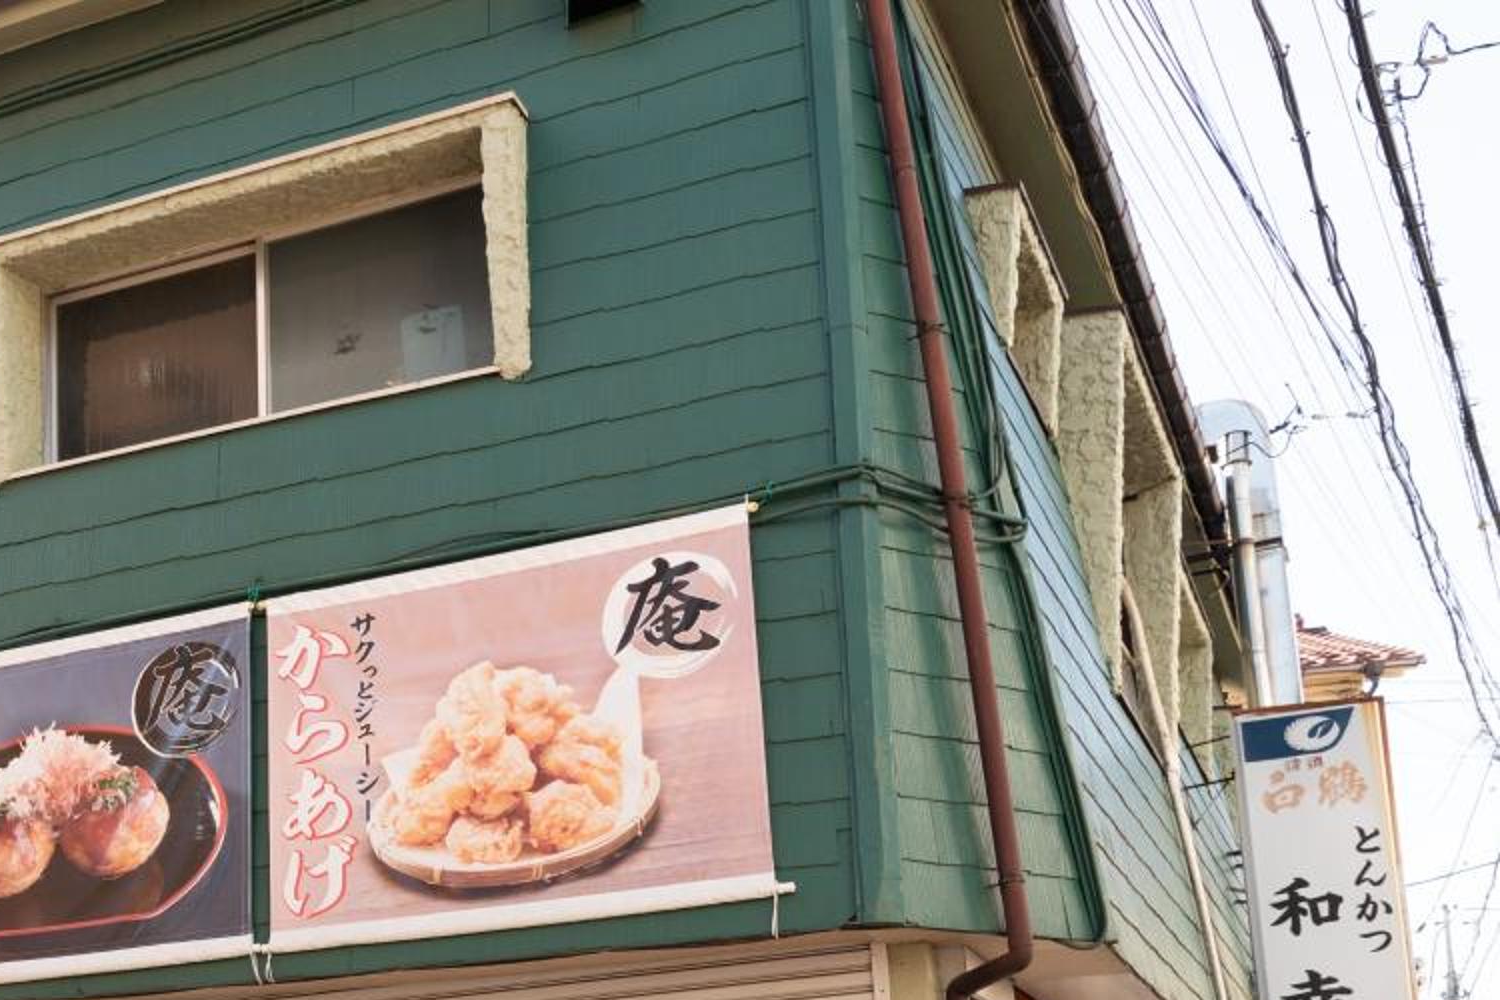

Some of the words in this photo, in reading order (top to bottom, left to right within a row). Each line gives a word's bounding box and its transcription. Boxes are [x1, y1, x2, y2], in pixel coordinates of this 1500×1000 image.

[614, 557, 722, 655] 庵
[143, 641, 228, 737] 庵
[275, 624, 357, 918] からあげ
[1354, 825, 1393, 953] とんかつ
